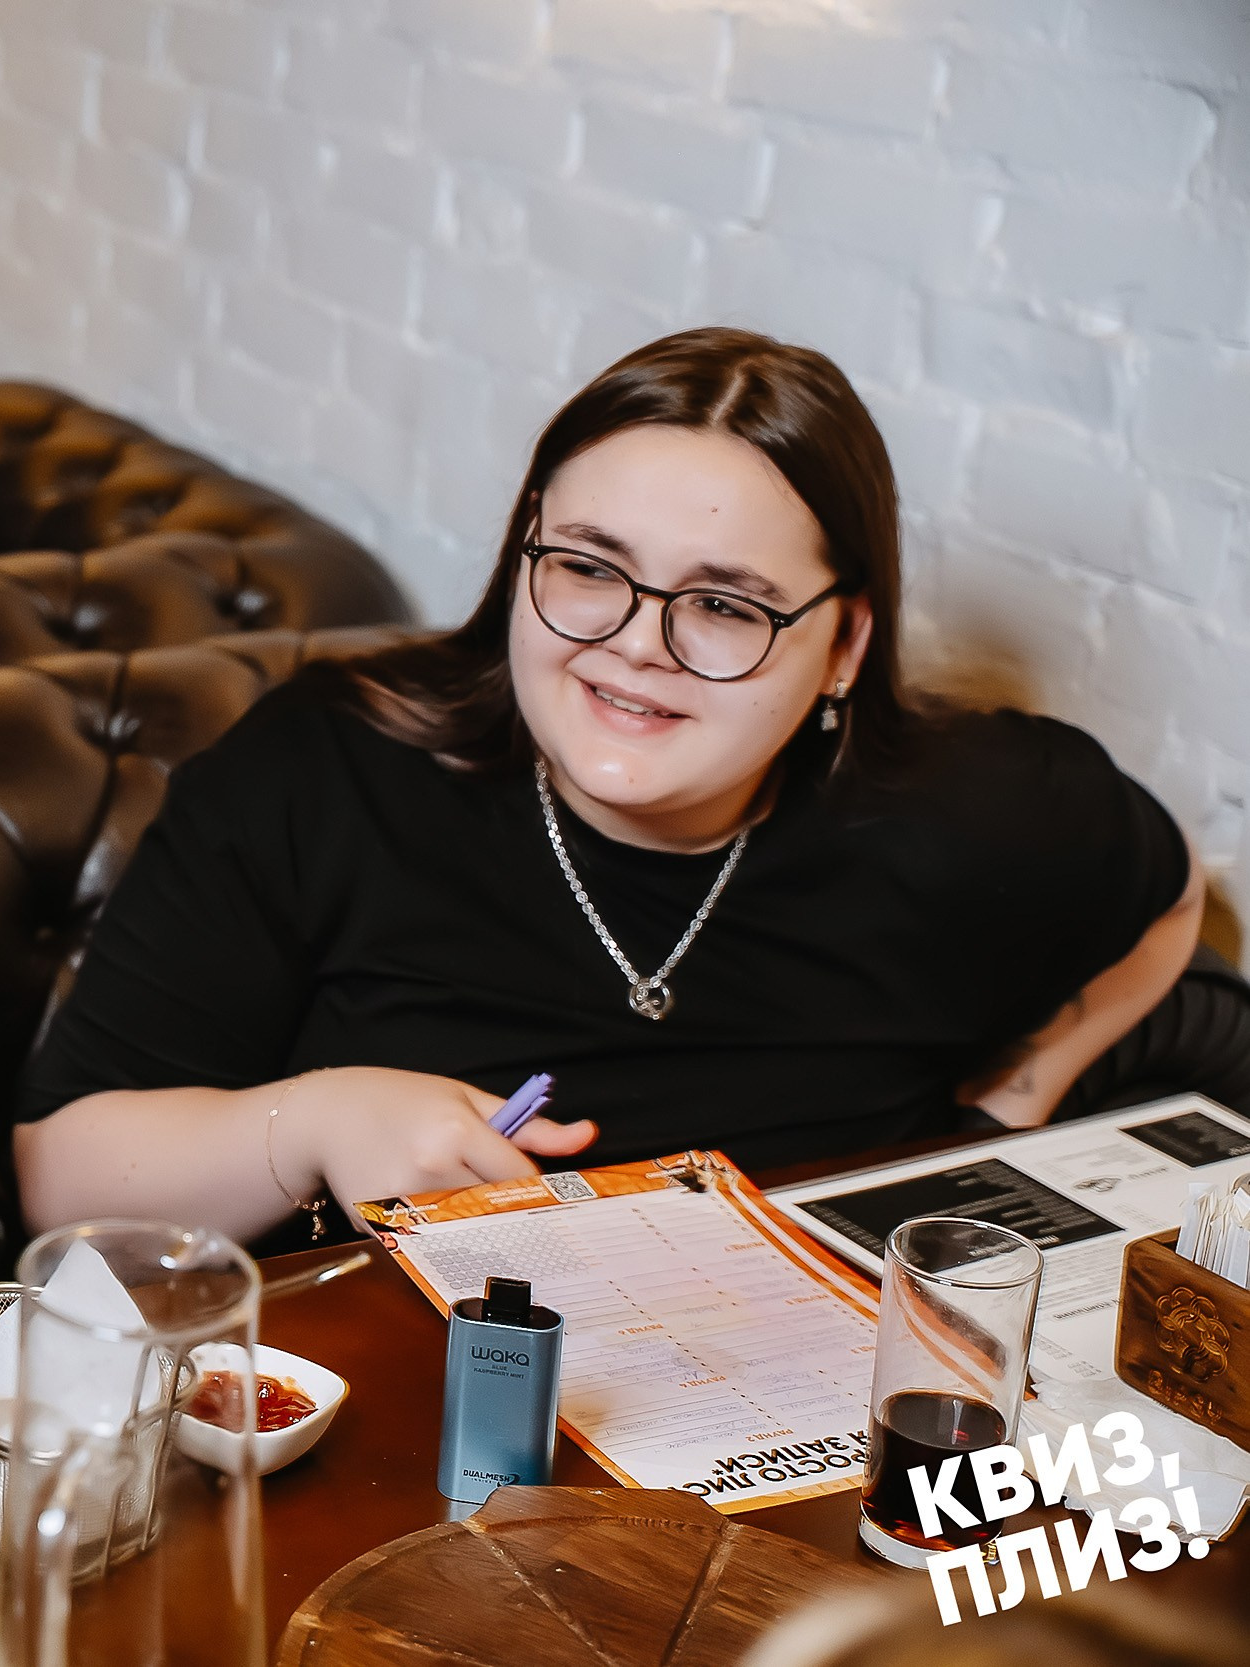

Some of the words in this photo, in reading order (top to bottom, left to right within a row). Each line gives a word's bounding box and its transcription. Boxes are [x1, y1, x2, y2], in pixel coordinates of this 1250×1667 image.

[753, 1428, 794, 1442] РАУНД
[759, 1447, 870, 1482] РОСТО
[463, 1469, 510, 1482] DUALMESH
[666, 1472, 757, 1497] ЛИС
